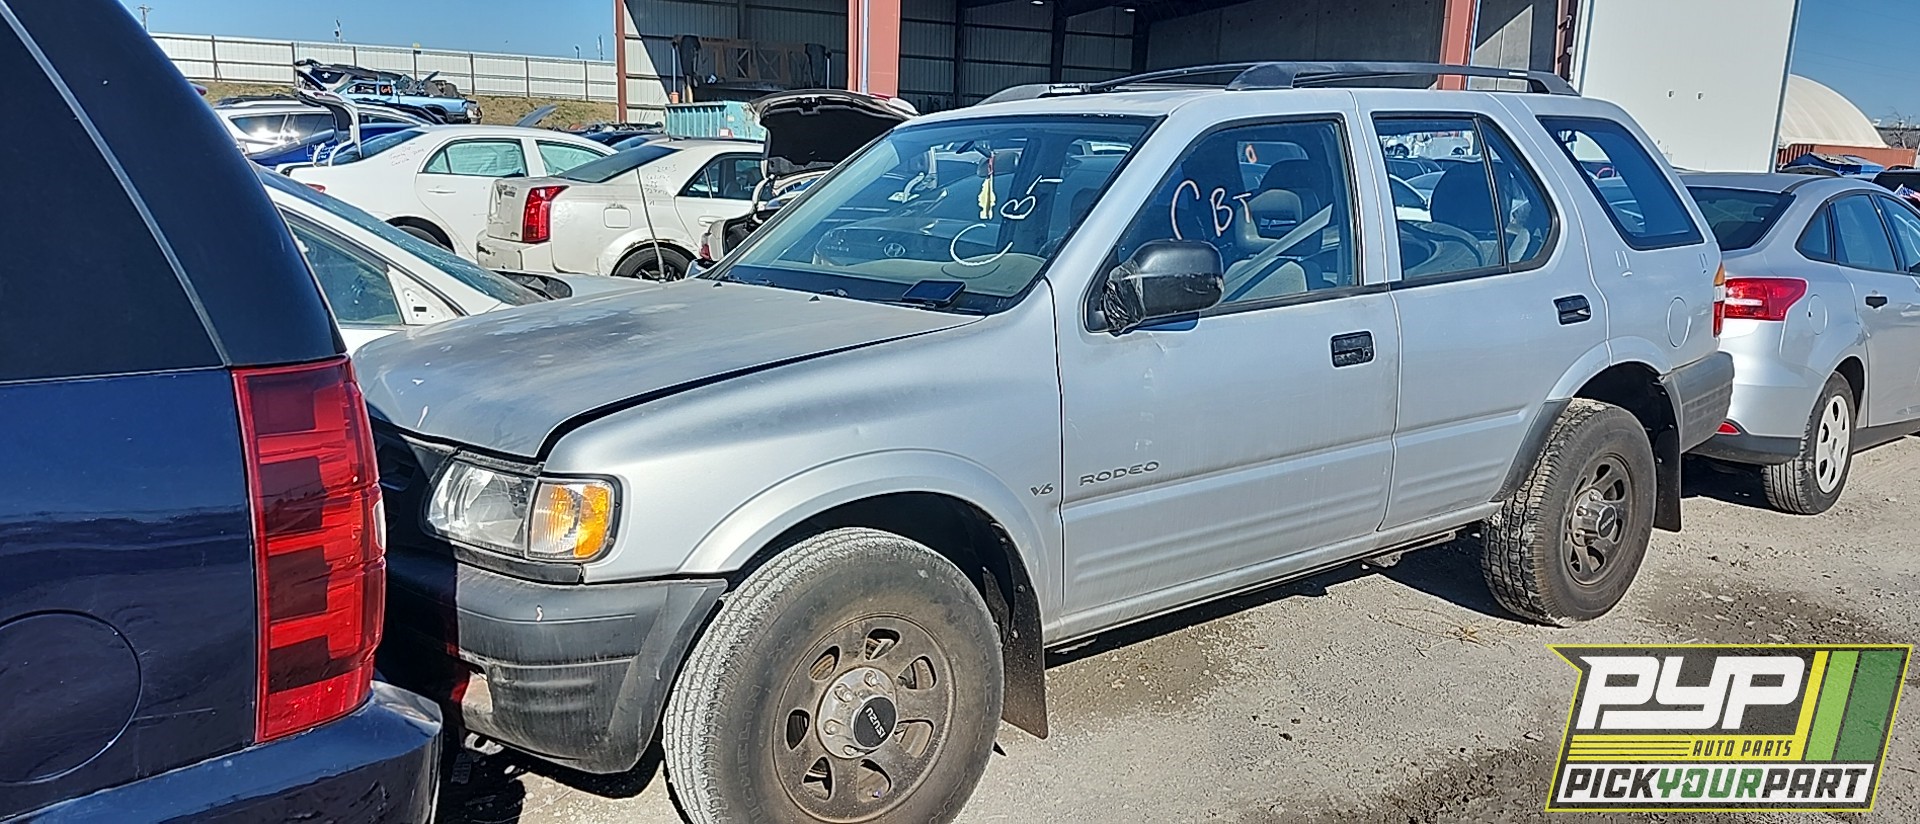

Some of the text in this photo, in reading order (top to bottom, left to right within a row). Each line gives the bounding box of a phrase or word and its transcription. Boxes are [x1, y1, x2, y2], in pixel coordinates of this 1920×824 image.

[1079, 461, 1160, 487] RODEO
[1030, 482, 1054, 496] V6
[865, 707, 887, 738] ISUZU
